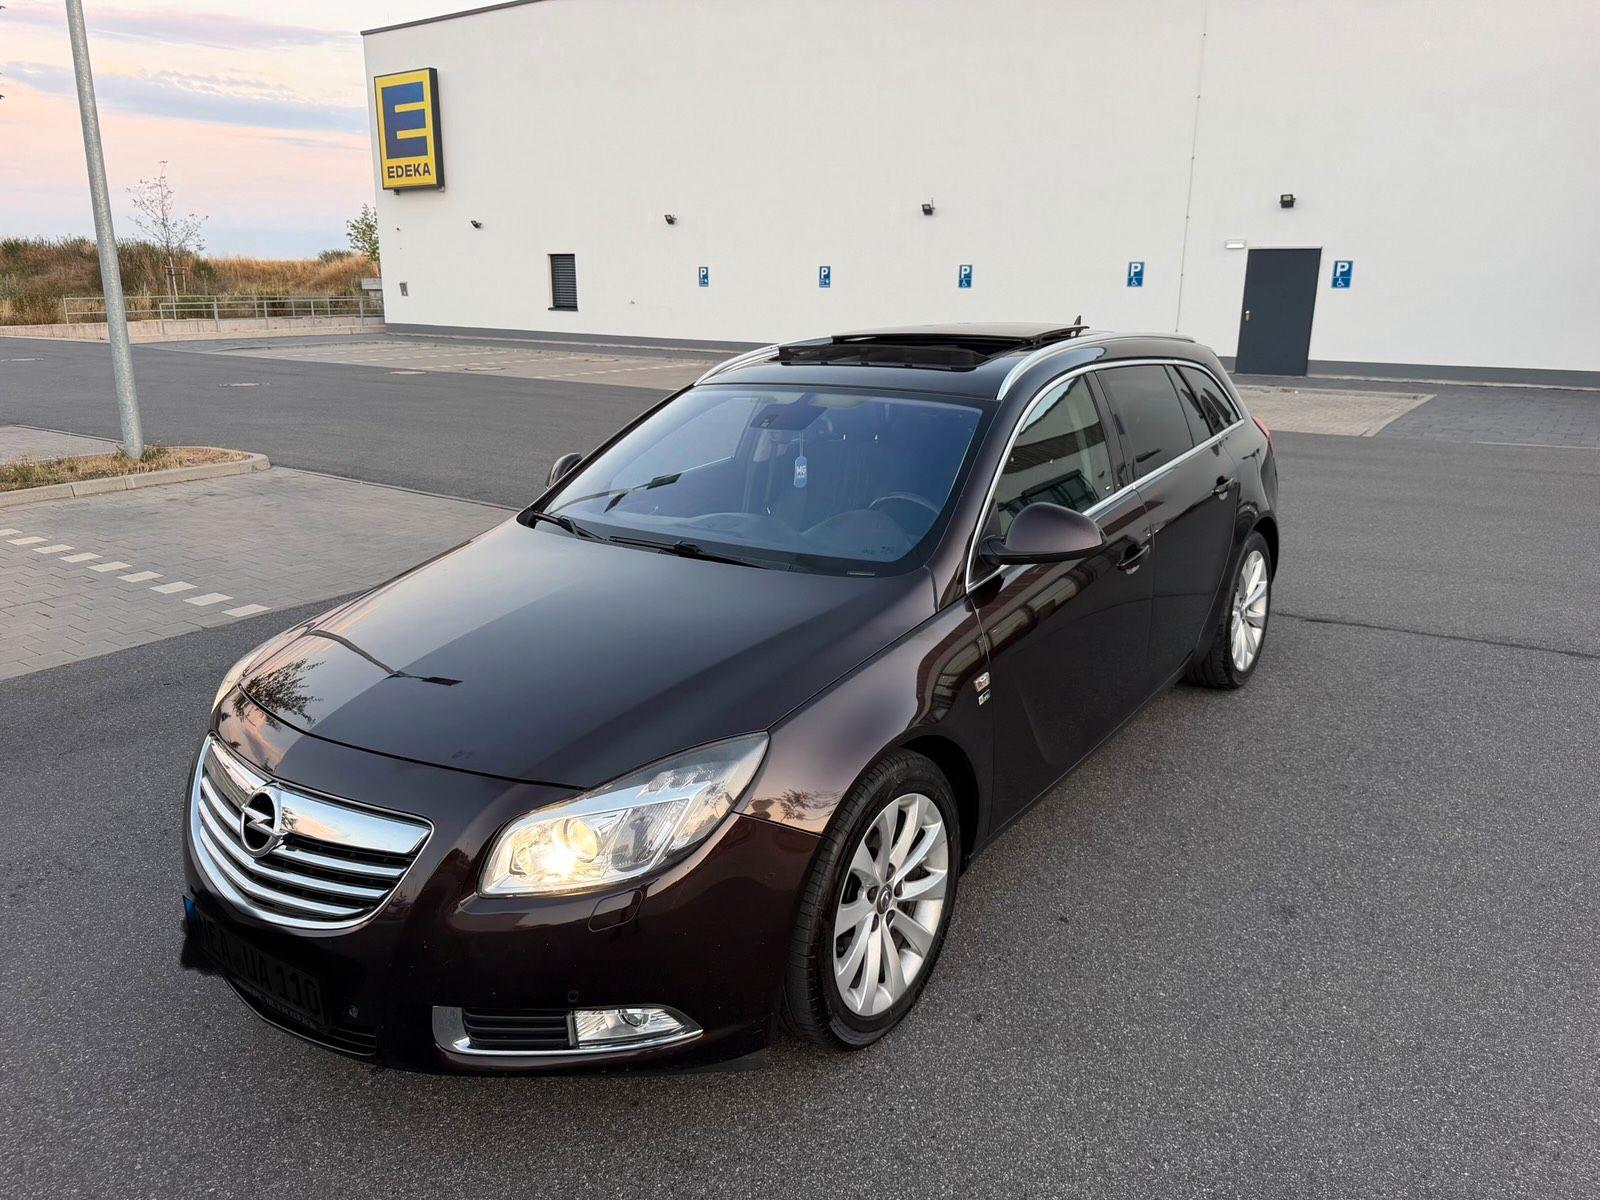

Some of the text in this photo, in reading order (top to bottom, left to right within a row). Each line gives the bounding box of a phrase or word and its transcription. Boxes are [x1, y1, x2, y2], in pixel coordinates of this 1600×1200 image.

[381, 81, 428, 160] E
[387, 162, 431, 179] EDEKA
[700, 268, 707, 279] P
[821, 268, 829, 279] P
[961, 266, 970, 278] P
[1130, 263, 1141, 277] P
[1335, 262, 1349, 277] P
